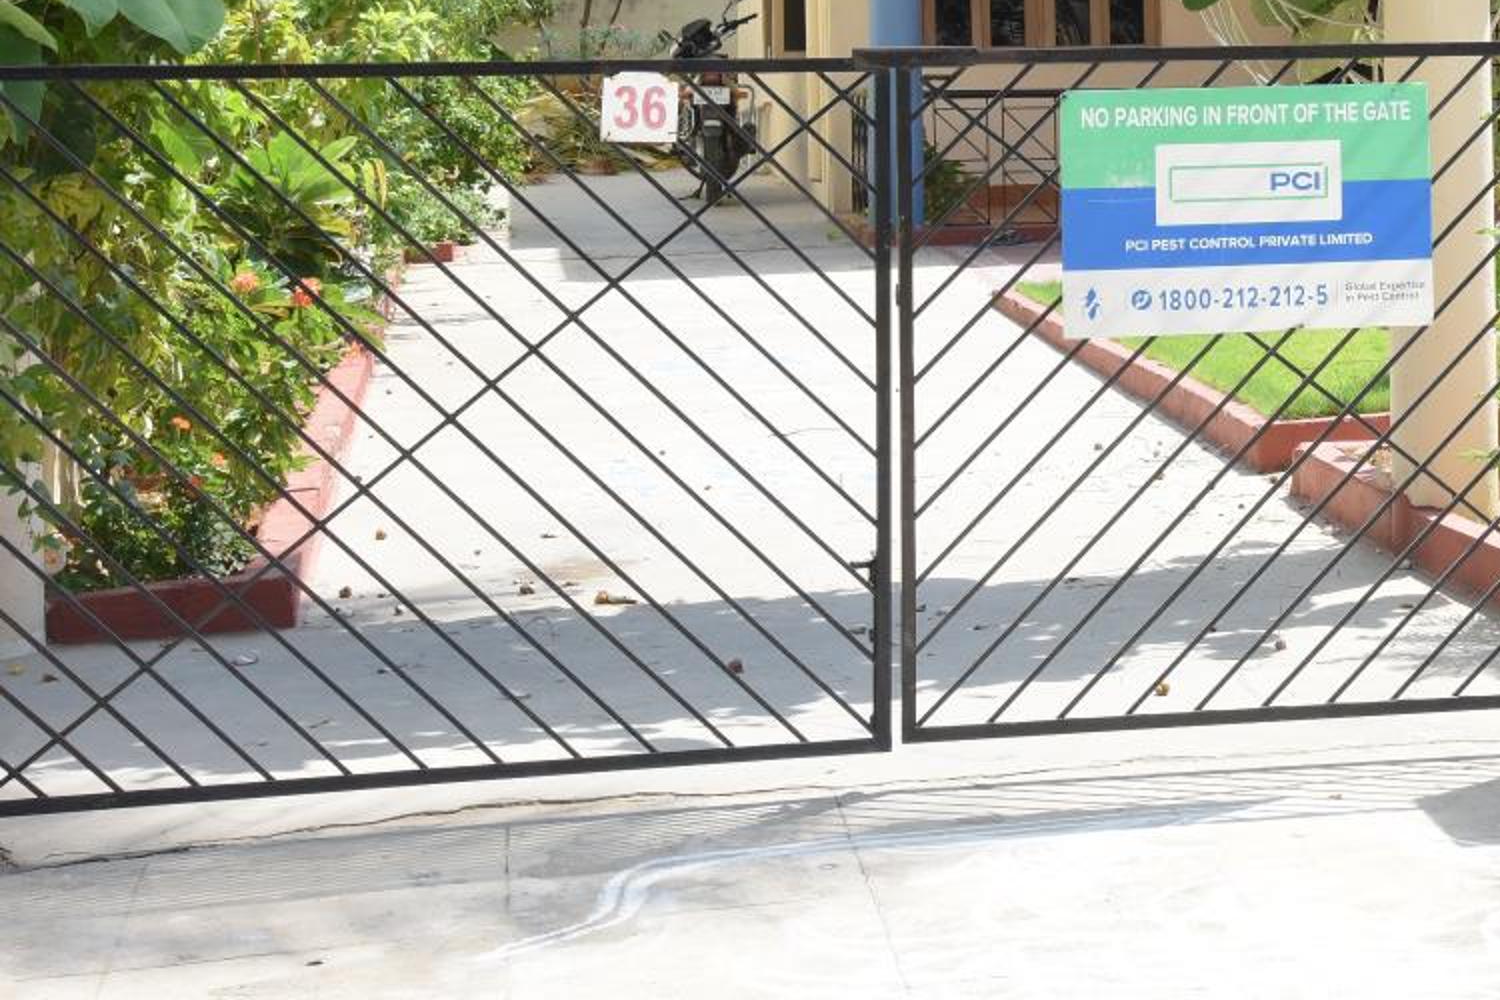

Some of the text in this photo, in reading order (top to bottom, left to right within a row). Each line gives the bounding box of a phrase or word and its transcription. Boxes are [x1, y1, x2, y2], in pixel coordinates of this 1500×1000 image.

[613, 85, 667, 130] 36
[1081, 100, 1412, 129] NO PARKING IN FRONT OF THE GATE
[1270, 171, 1321, 191] PCI
[1151, 238, 1185, 251] PEST
[1189, 236, 1256, 250] CONTROL
[1259, 234, 1317, 248] PRIVATE
[1319, 232, 1373, 245] LIMITED
[1158, 284, 1328, 311] 1800-212-212-5
